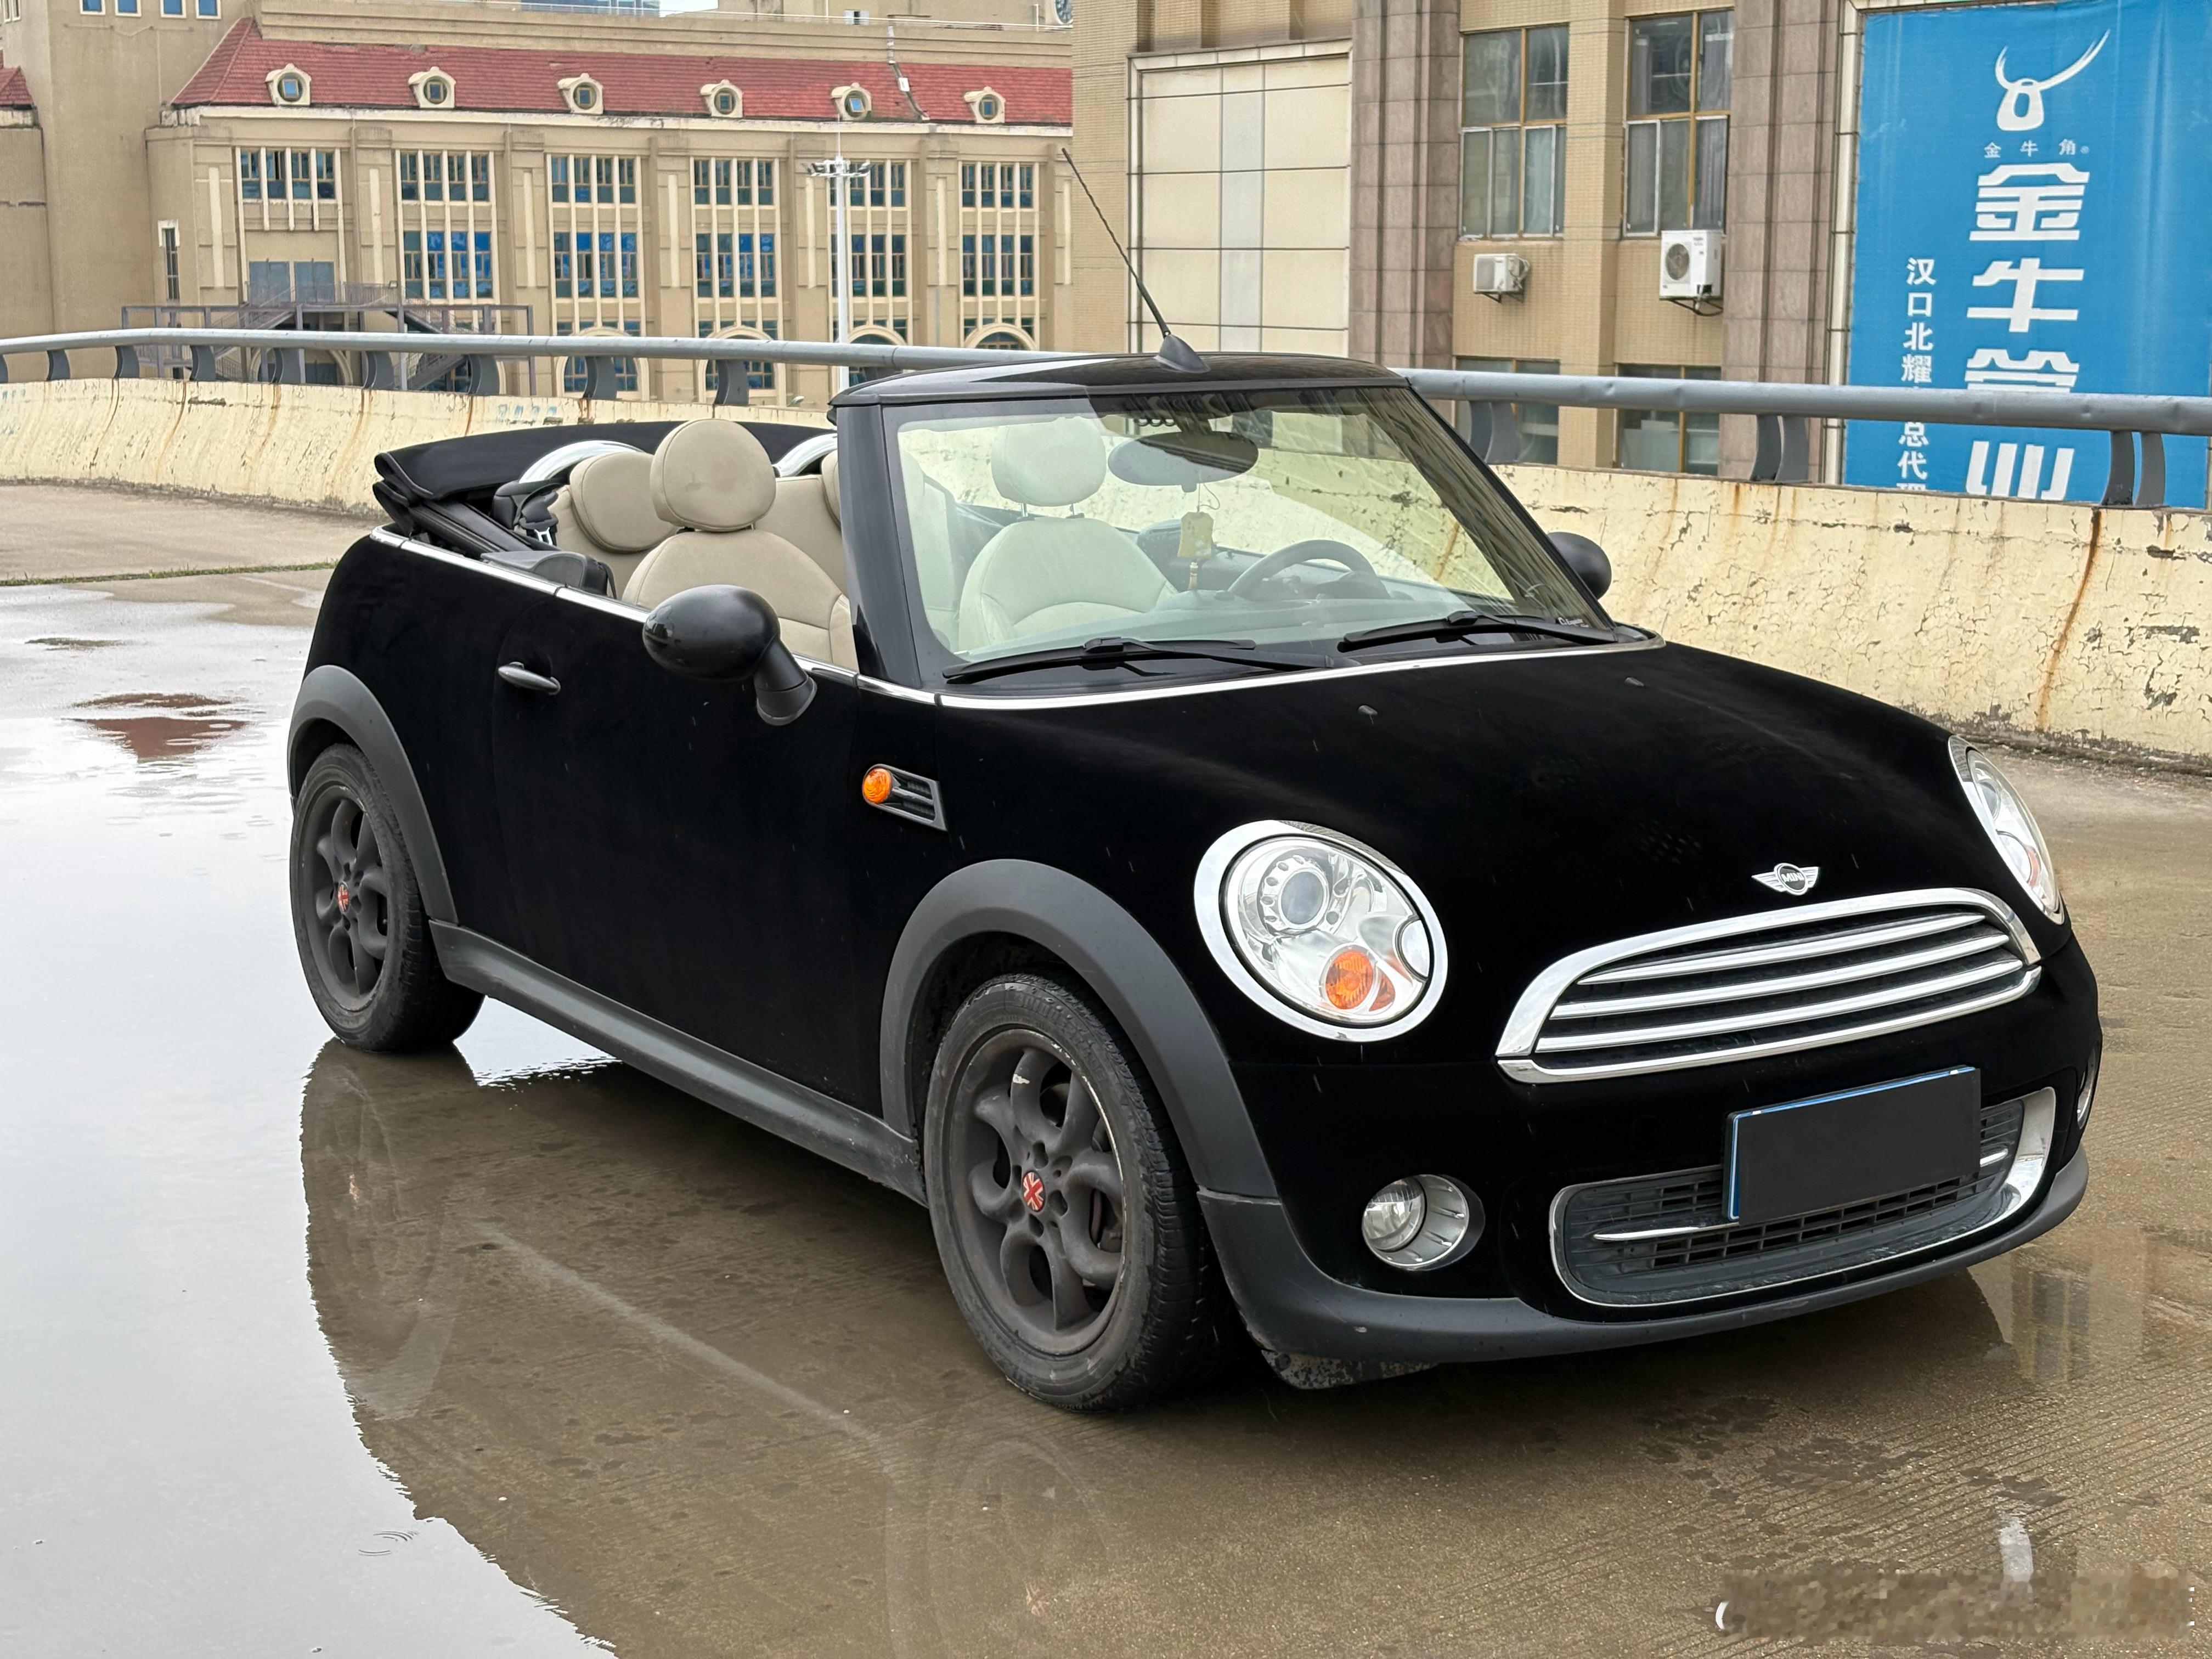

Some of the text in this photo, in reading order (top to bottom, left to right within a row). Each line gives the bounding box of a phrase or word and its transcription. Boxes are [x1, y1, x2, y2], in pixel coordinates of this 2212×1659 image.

[1984, 139, 2076, 158] 金牛角
[1897, 257, 1936, 490] 汉口北耀总代
[1781, 872, 1804, 883] MINI
